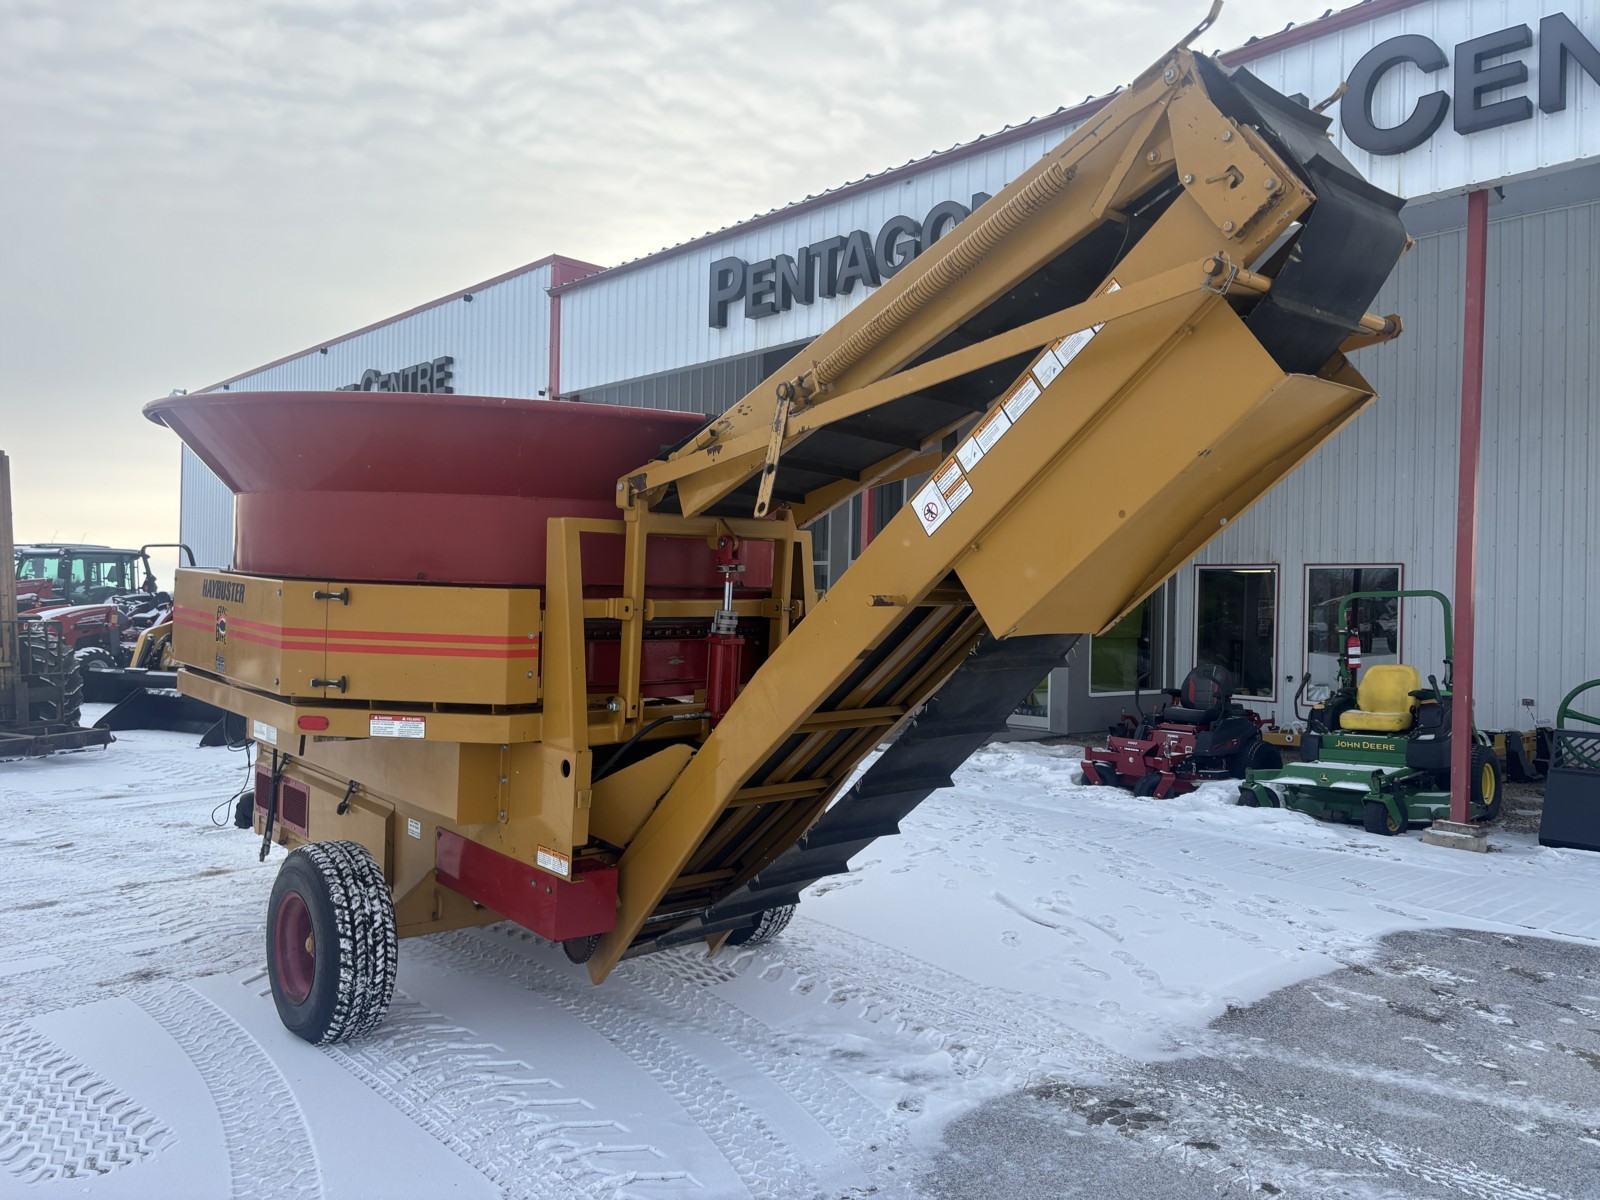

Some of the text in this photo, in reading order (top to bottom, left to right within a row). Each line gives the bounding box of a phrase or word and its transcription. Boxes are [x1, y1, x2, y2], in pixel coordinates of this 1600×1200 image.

[709, 192, 993, 329] PENTAGO
[202, 578, 246, 604] HAYBUSTER
[1335, 740, 1396, 751] JOHN DEERE
